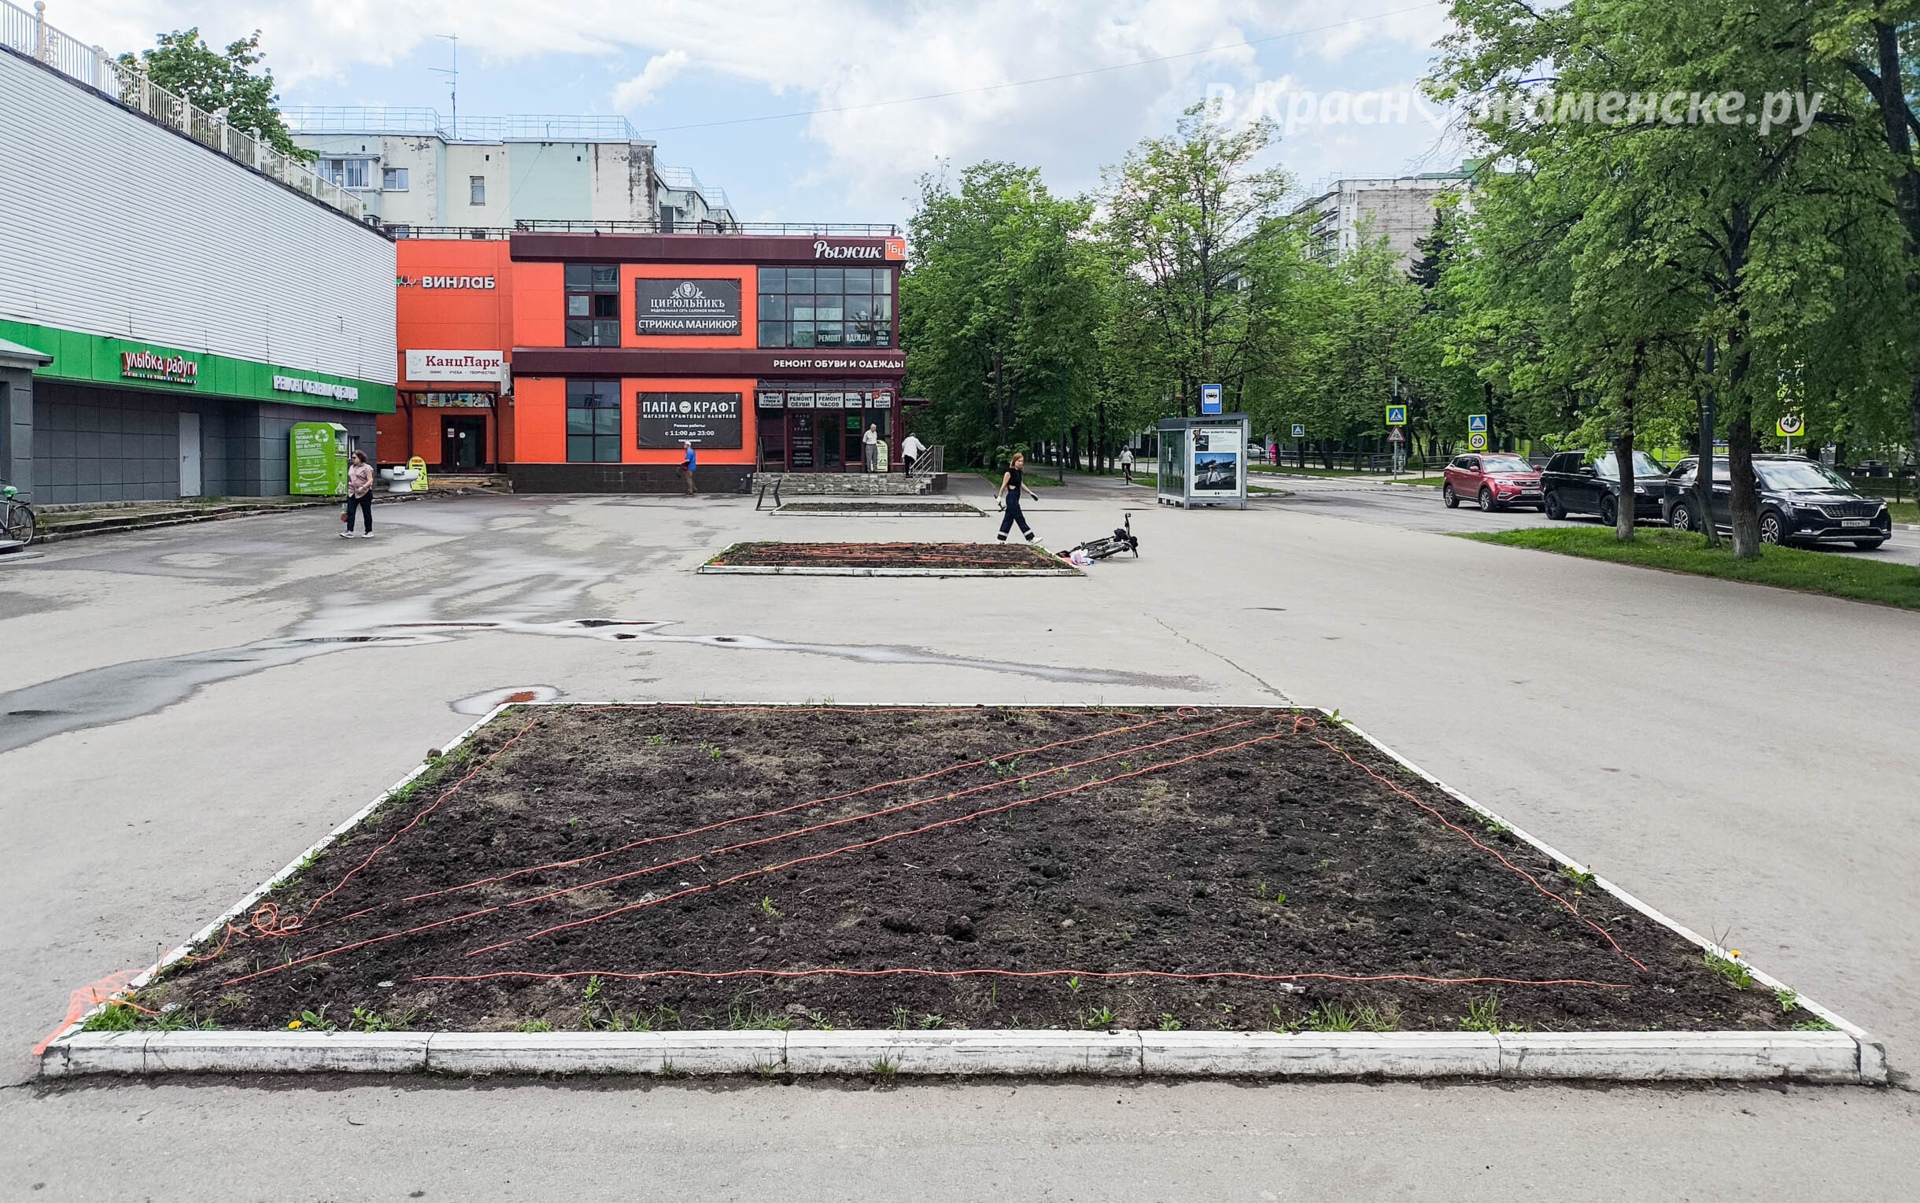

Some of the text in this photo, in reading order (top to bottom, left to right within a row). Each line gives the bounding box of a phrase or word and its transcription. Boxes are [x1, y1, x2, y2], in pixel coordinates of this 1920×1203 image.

[813, 240, 905, 259] Рыжик ТБЦ
[650, 298, 726, 309] ЦИРЮЛЬНИКЪ
[638, 319, 738, 329] СТРИЖКА МАНИКЮР
[122, 350, 198, 378] улыбка радуги
[425, 355, 500, 370] КанцПарк
[773, 359, 904, 369] РЕМОНТ ОБУВИ И ОДЕЖДЫ
[642, 401, 737, 413] ПАПА КРАФТ
[1473, 437, 1483, 445] 20
